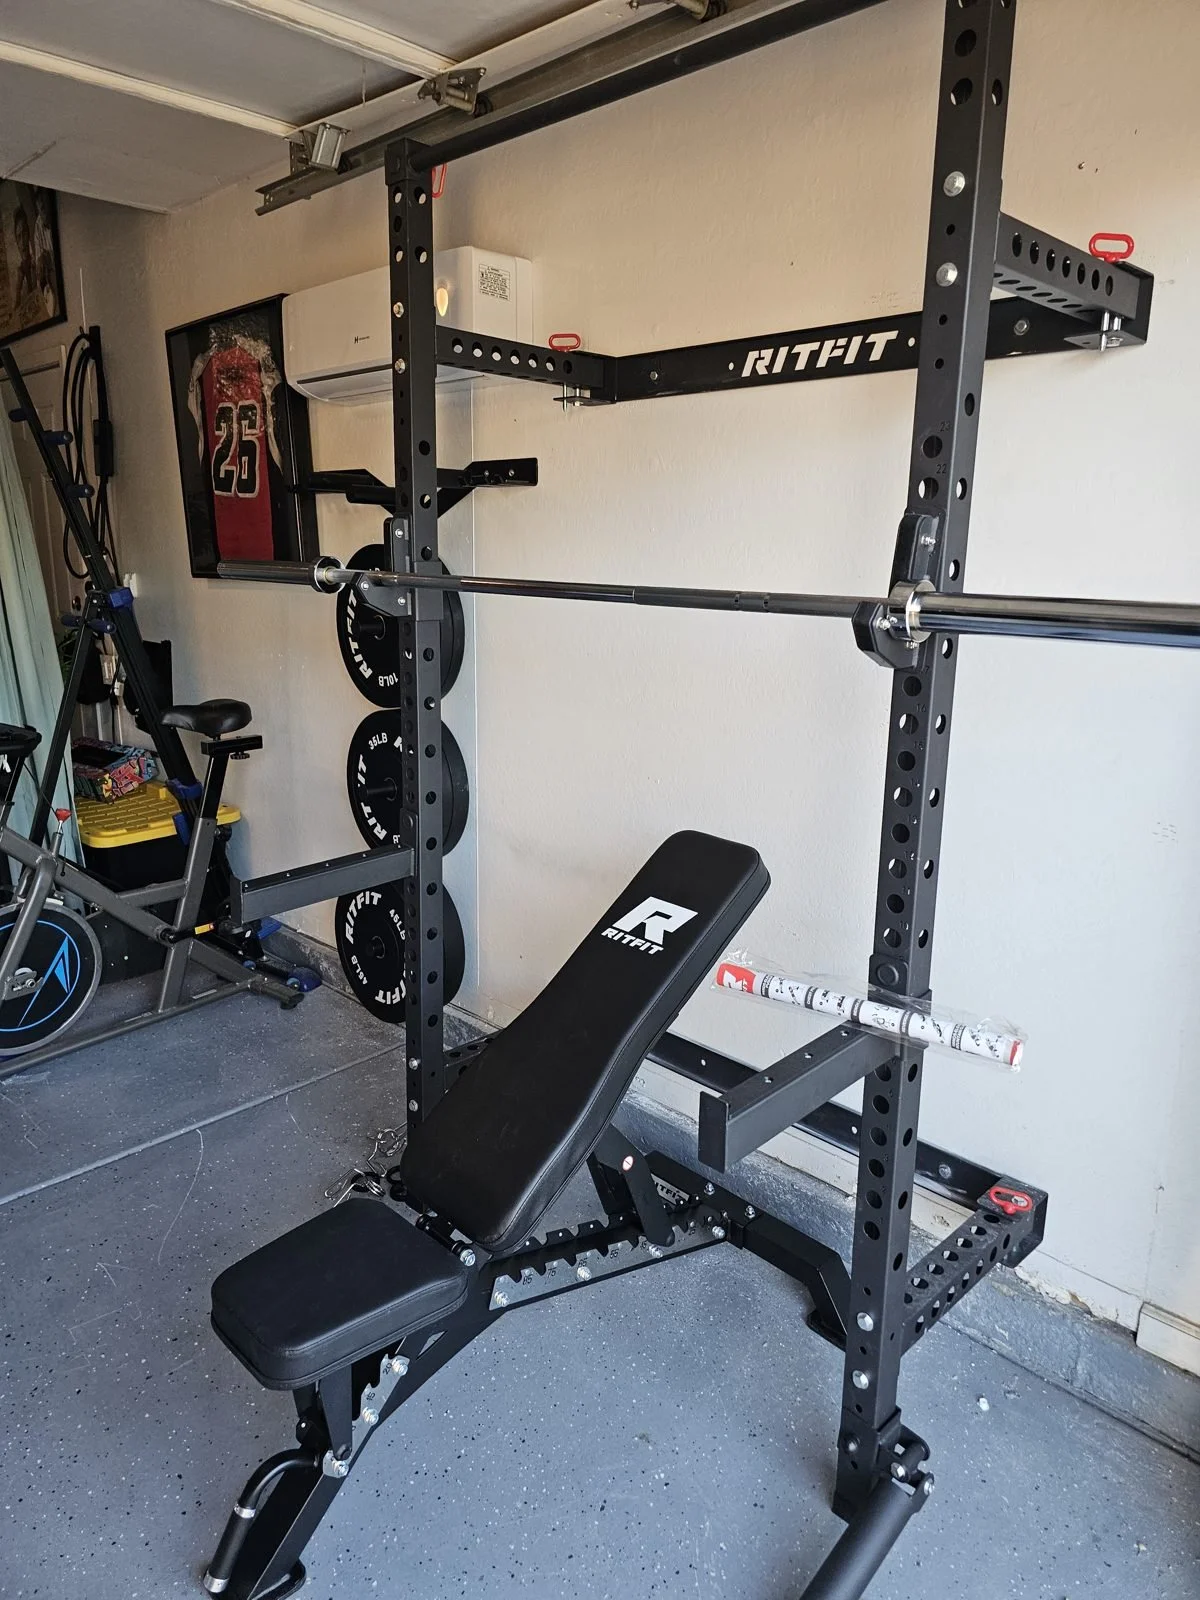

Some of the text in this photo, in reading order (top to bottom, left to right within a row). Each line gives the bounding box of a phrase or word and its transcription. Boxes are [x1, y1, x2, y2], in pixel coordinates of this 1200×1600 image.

[741, 330, 899, 378] RITFIT
[211, 399, 260, 498] 26
[378, 672, 399, 687] 10LB
[368, 732, 388, 751] 35LB
[357, 753, 388, 841] RITIT
[345, 890, 382, 945] RITFIT
[600, 927, 665, 955] RITFIT
[382, 1362, 393, 1375] 20
